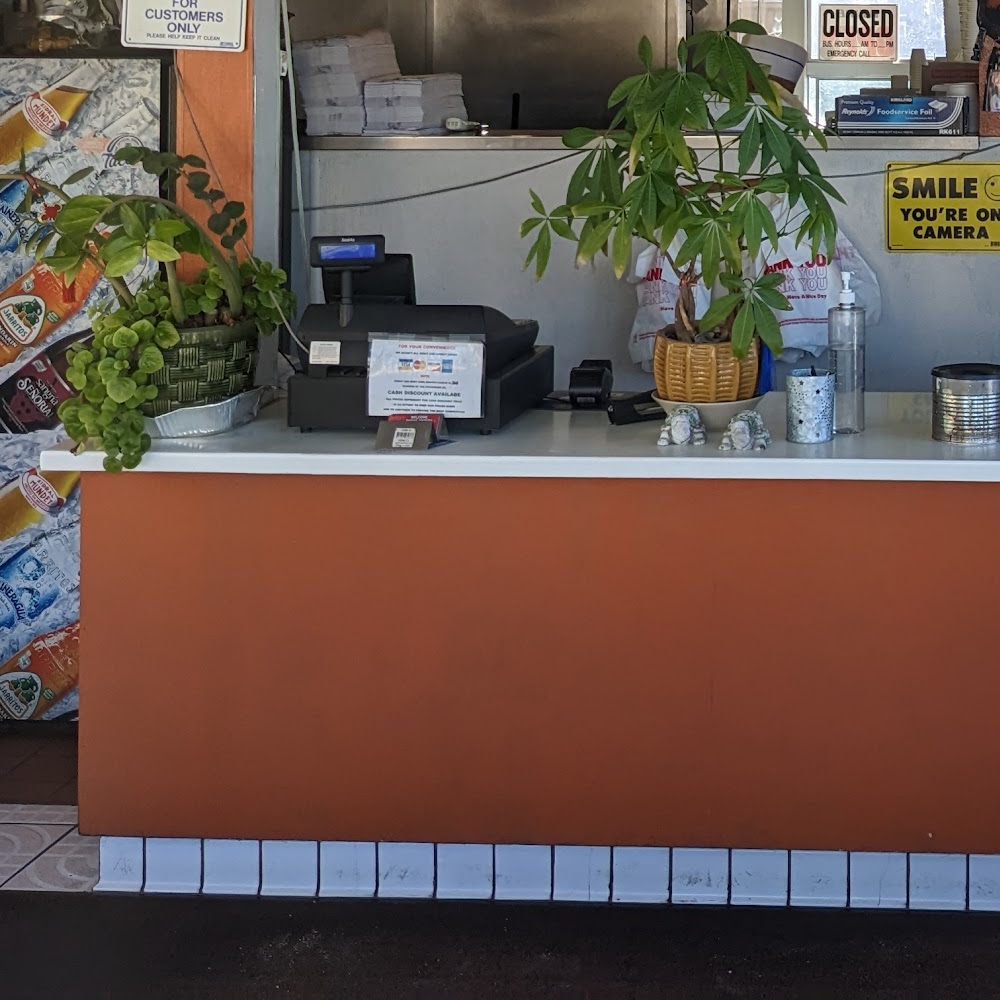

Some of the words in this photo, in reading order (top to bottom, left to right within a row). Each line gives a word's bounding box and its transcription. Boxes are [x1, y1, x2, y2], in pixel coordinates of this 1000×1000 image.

[145, 9, 223, 22] CUSTOMERS
[823, 9, 894, 38] CLOSED
[167, 22, 201, 33] ONLY
[33, 103, 56, 129] MUNDET
[892, 177, 977, 199] SMILE
[900, 208, 967, 222] YOU'RE
[913, 226, 989, 239] CAMERA
[3, 309, 28, 337] JARRITOS
